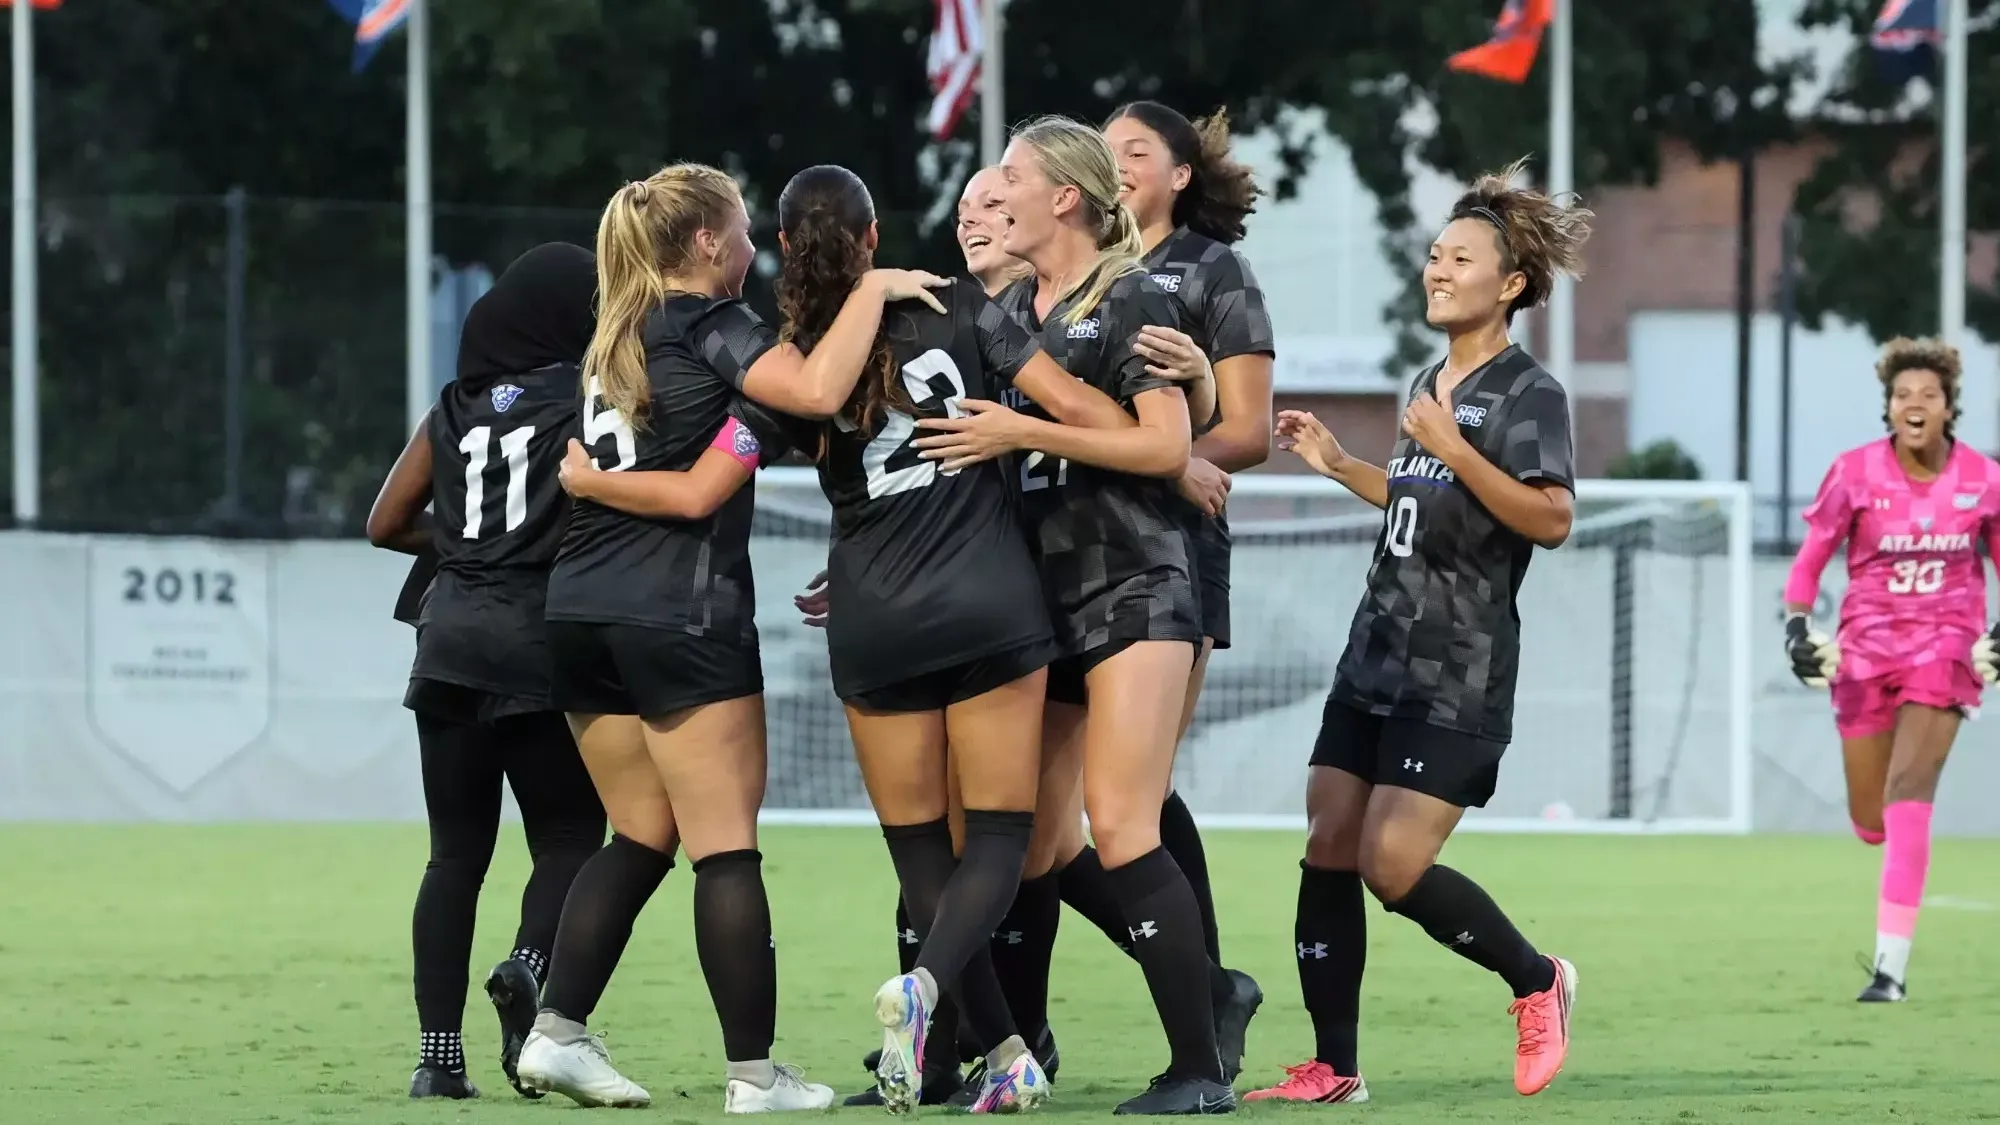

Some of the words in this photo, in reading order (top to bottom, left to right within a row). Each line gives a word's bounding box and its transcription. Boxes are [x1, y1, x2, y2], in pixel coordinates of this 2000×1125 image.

[1454, 404, 1487, 427] SBC
[458, 425, 536, 539] 11
[1878, 532, 1970, 553] ATLANTA
[121, 566, 237, 603] 2012
[1887, 559, 1946, 594] 30
